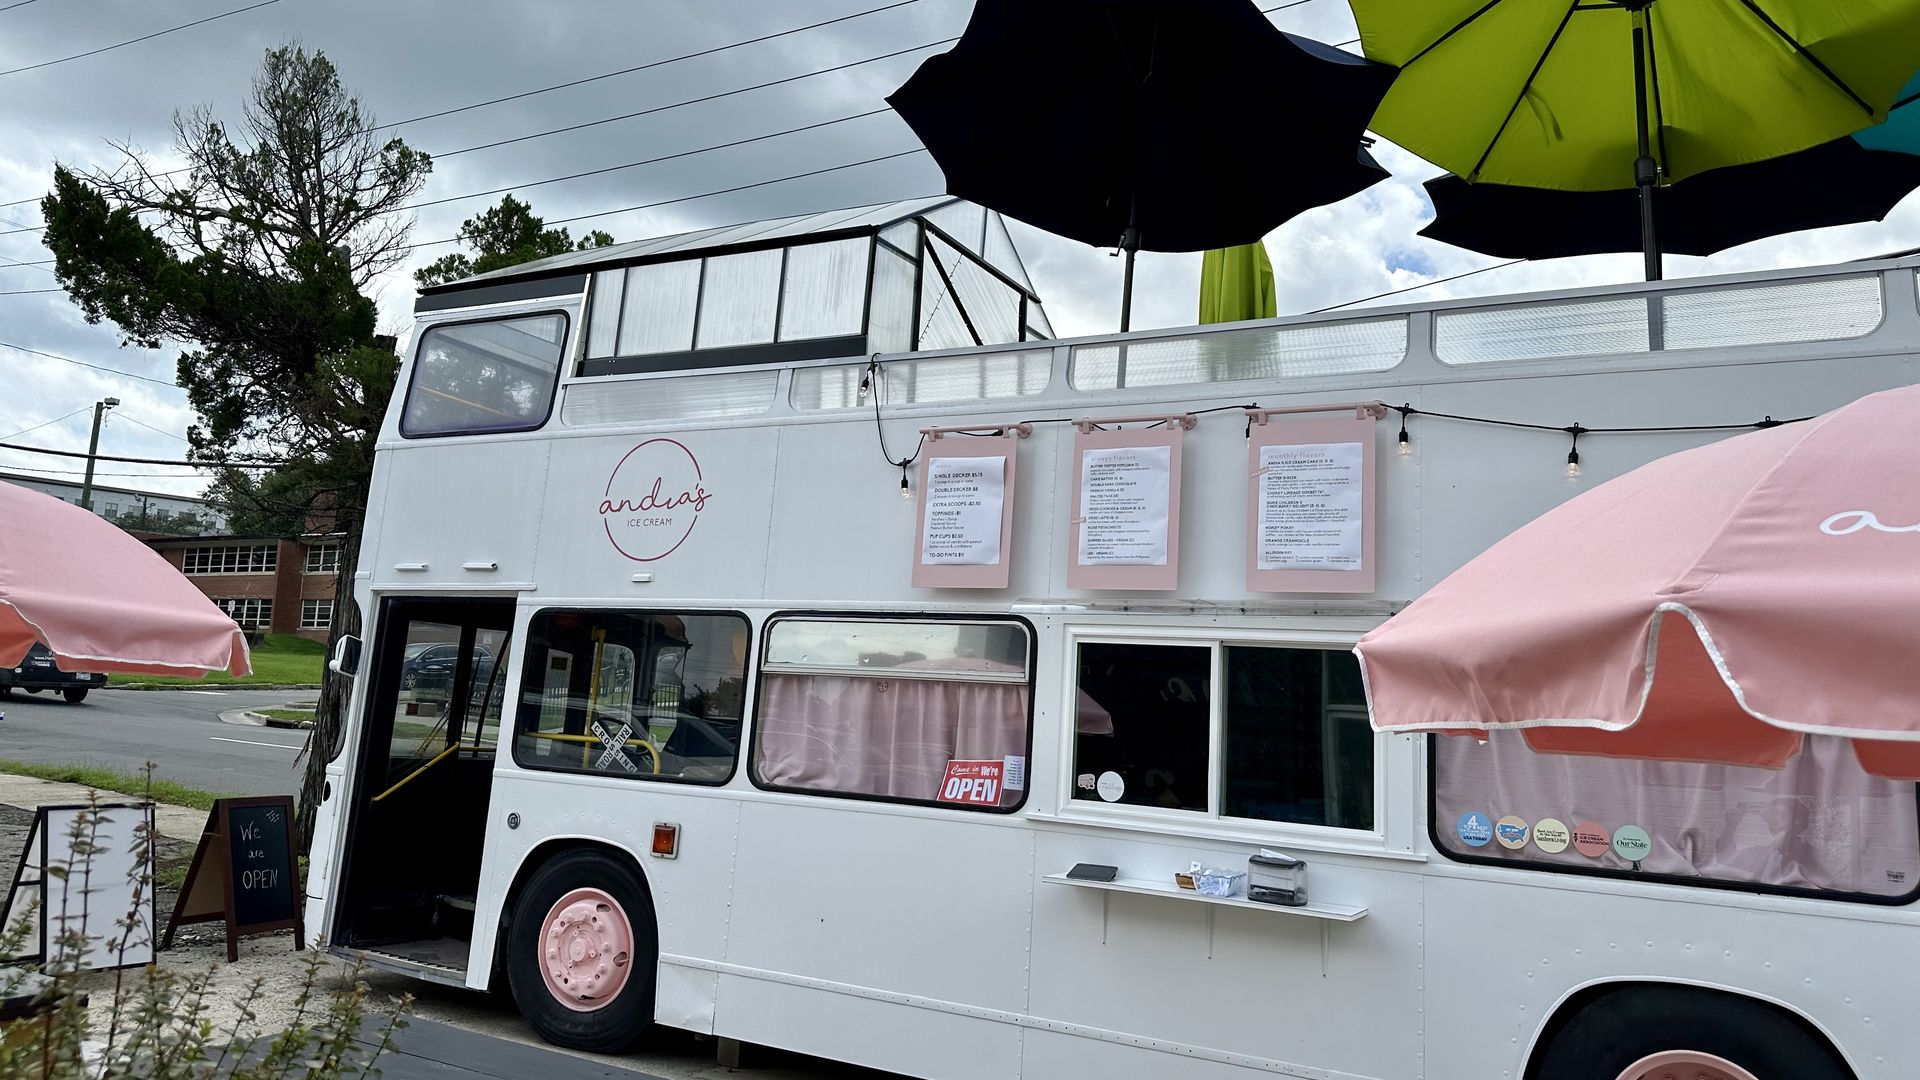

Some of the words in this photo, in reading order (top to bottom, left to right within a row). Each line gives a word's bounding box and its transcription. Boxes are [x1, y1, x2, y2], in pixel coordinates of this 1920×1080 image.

[600, 476, 712, 514] andia's
[626, 518, 641, 527] ICE
[643, 518, 672, 527] CREAM
[614, 727, 630, 745] RAIL
[594, 725, 636, 774] CROSSING
[951, 765, 970, 774] Come
[981, 766, 999, 776] We're
[944, 777, 998, 802] OPEN
[240, 821, 262, 840] We
[1468, 815, 1478, 829] 4
[248, 850, 264, 859] are
[242, 868, 278, 890] OPEN
